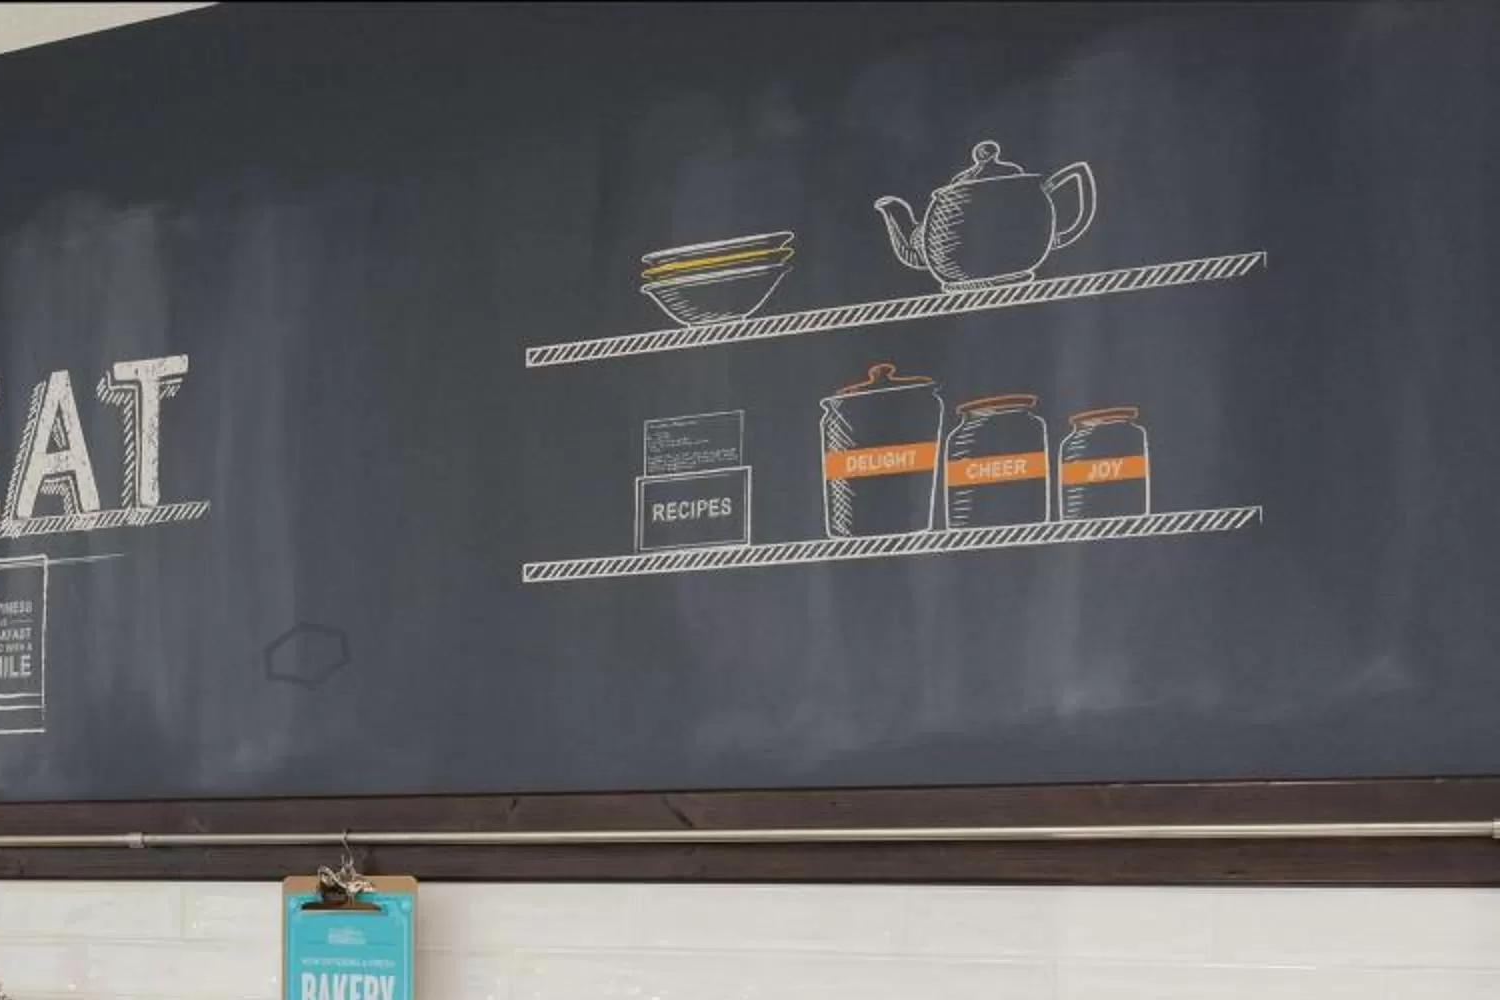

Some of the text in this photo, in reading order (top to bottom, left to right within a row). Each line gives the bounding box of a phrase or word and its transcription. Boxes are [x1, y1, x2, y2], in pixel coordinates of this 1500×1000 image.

[846, 451, 917, 473] DELIGHT
[965, 458, 1028, 481] CHEER
[1088, 462, 1123, 482] JOY
[652, 498, 732, 522] RECIPES
